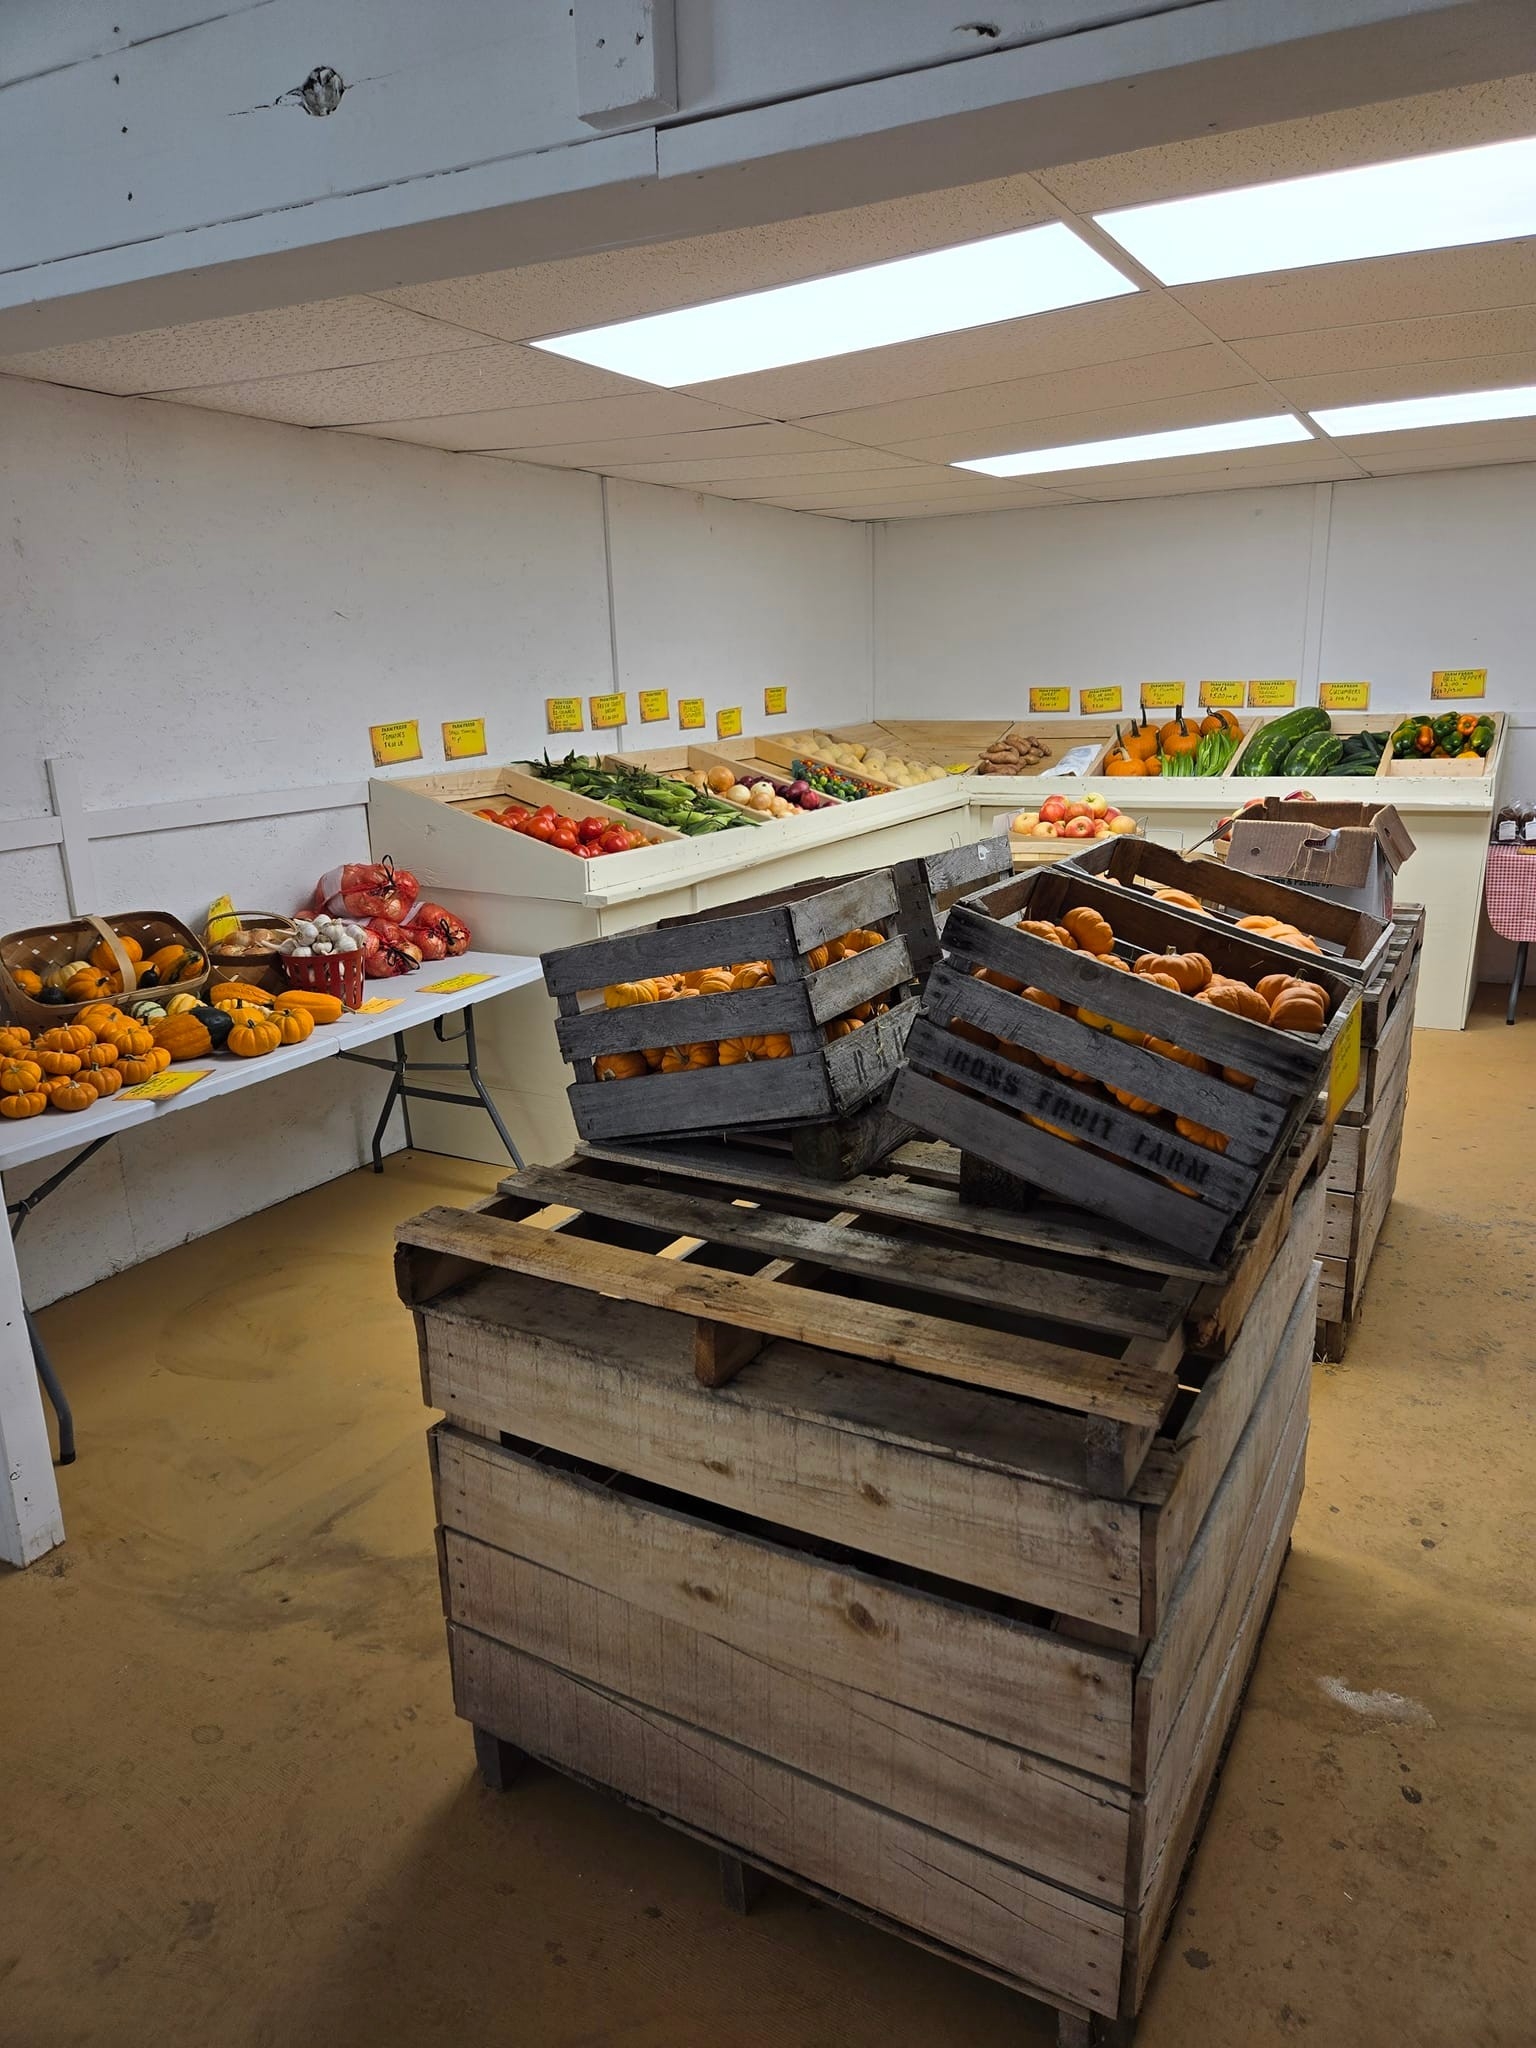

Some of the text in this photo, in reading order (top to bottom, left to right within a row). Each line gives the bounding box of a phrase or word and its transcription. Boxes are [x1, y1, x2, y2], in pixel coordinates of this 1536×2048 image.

[941, 1047, 1019, 1096] IRONS
[1035, 1090, 1116, 1141] FRUIT
[1133, 1132, 1210, 1185] FARM
